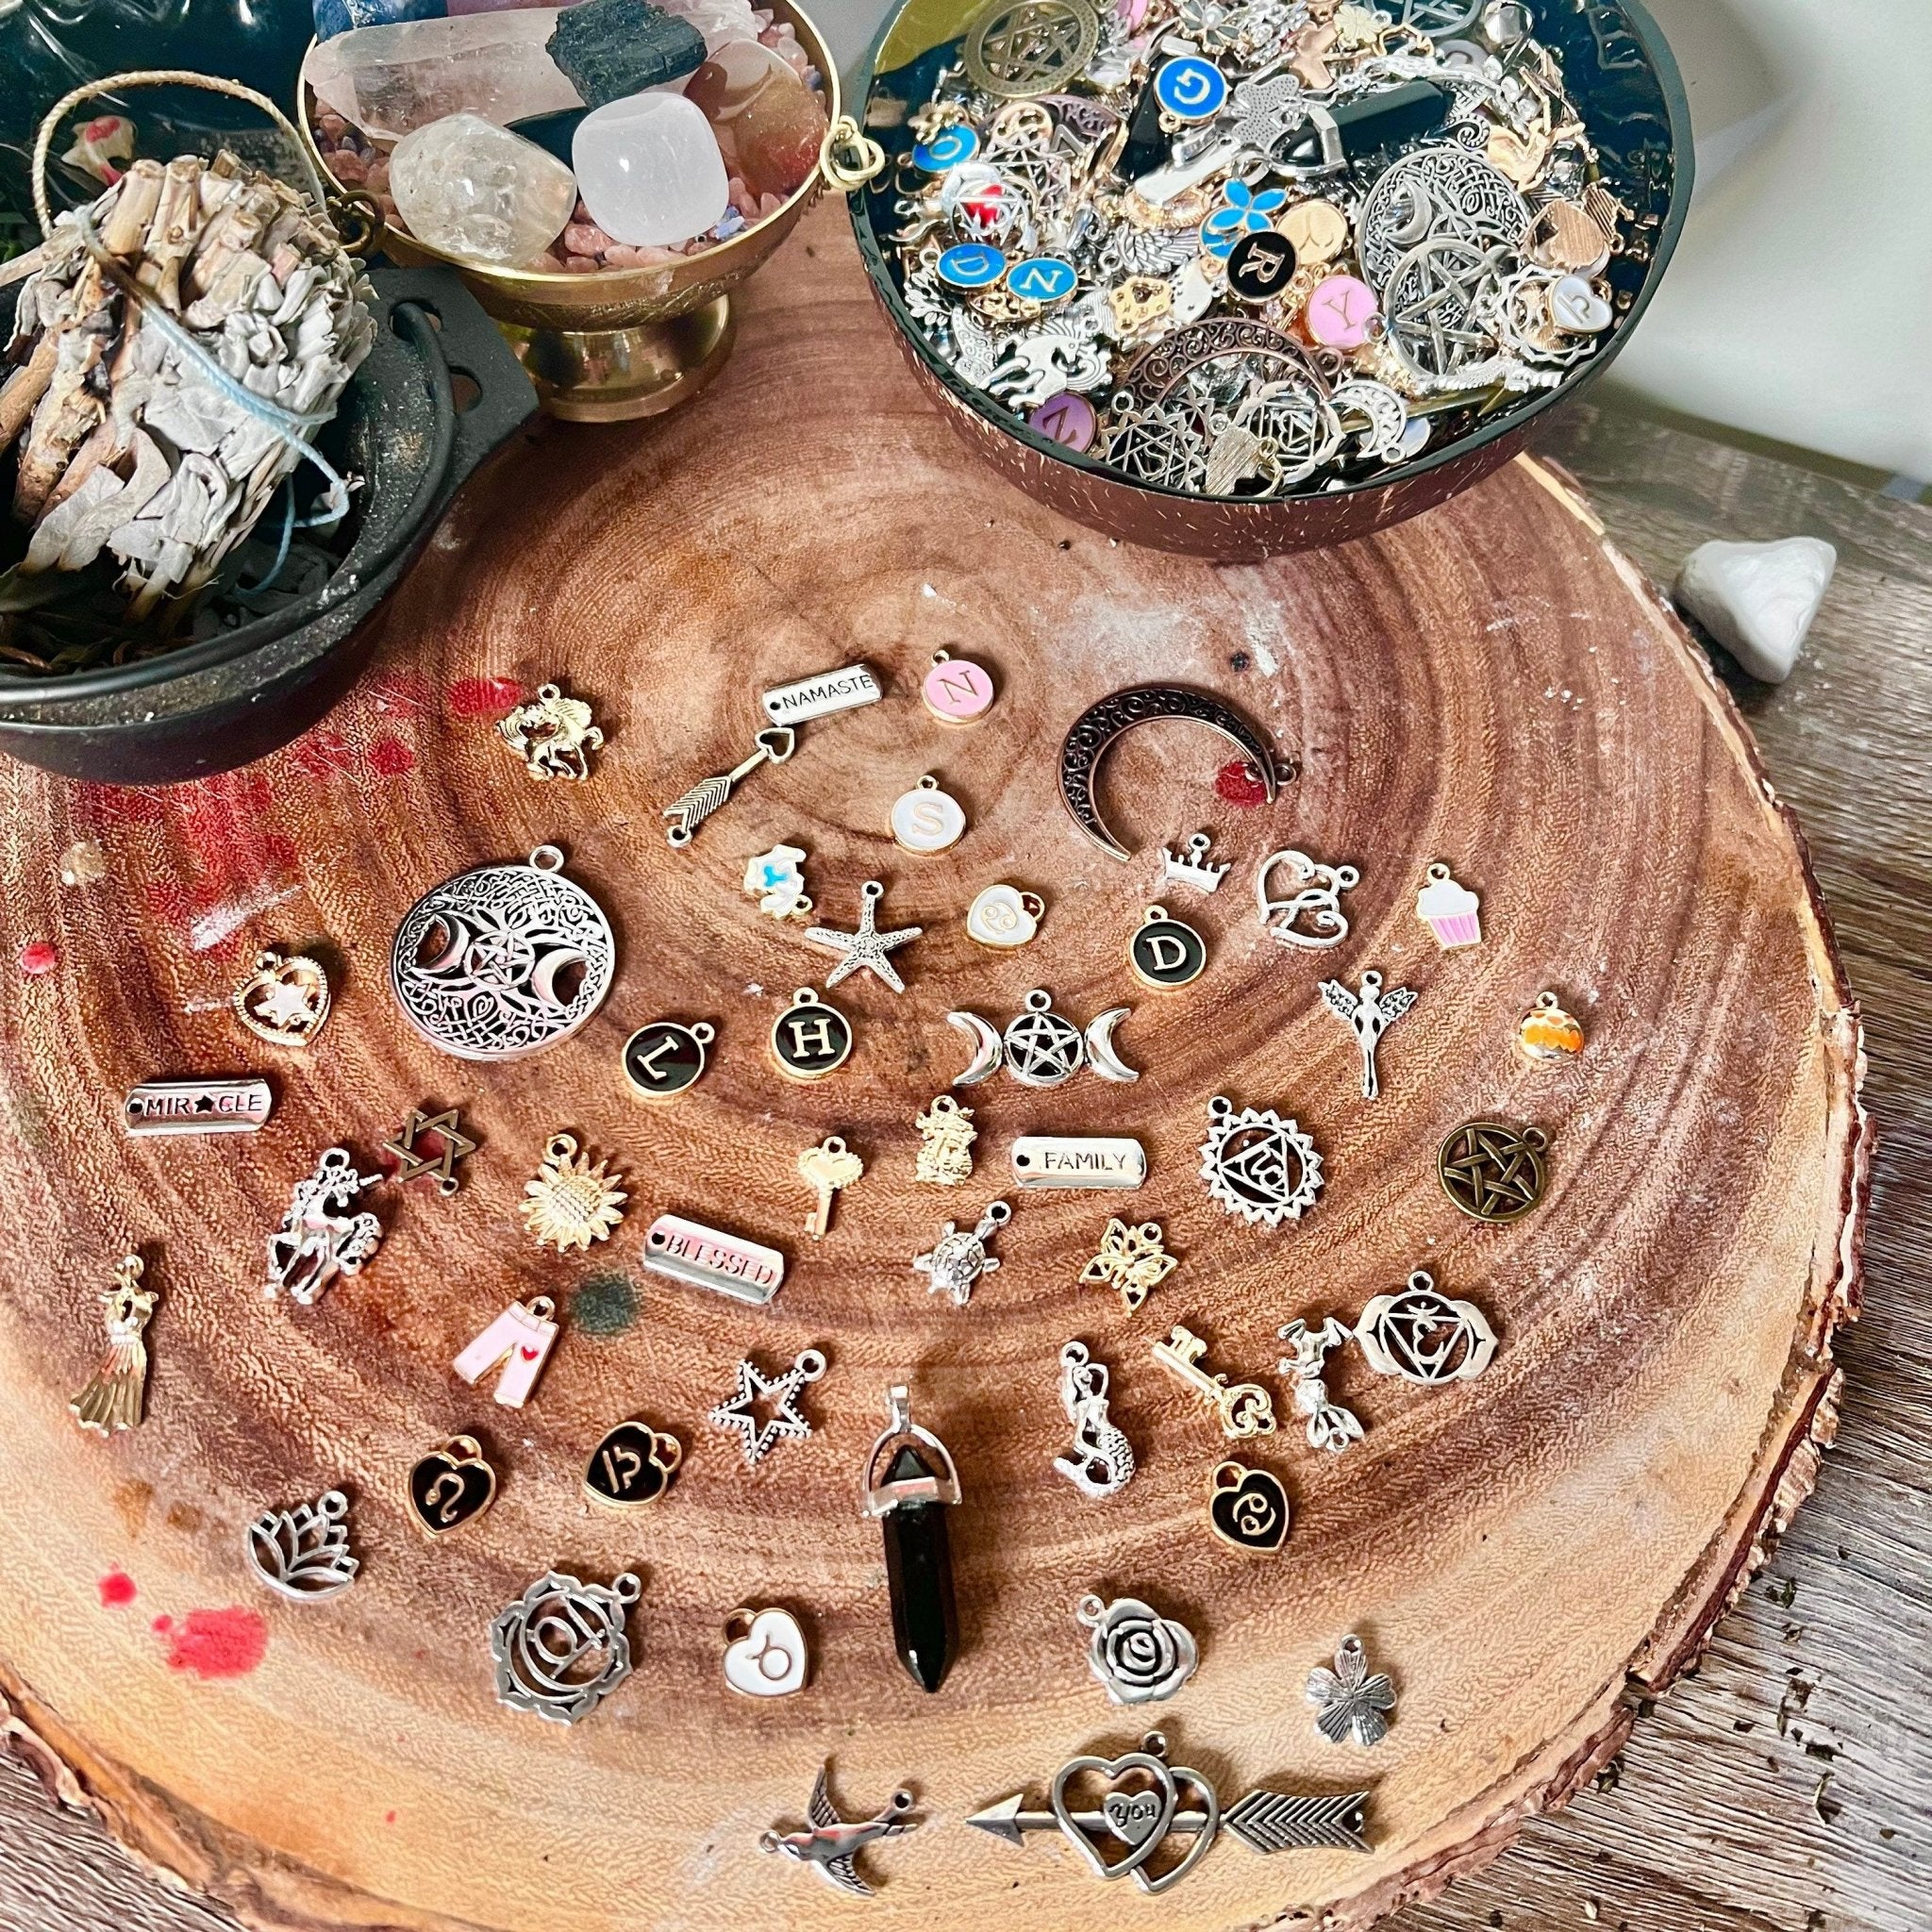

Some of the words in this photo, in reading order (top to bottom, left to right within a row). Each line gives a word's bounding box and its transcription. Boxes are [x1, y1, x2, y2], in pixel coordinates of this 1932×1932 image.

[1174, 68, 1211, 105] G
[950, 252, 991, 276] D
[1239, 242, 1286, 284] R
[1321, 290, 1357, 332] Y
[781, 674, 874, 710] NAMASTE
[936, 670, 980, 706] N
[910, 802, 944, 836] S
[1145, 935, 1188, 972] D
[788, 1017, 836, 1058] H
[636, 1034, 679, 1081] L
[1043, 1151, 1127, 1172] FAMILY
[665, 1234, 774, 1285] BLESSED
